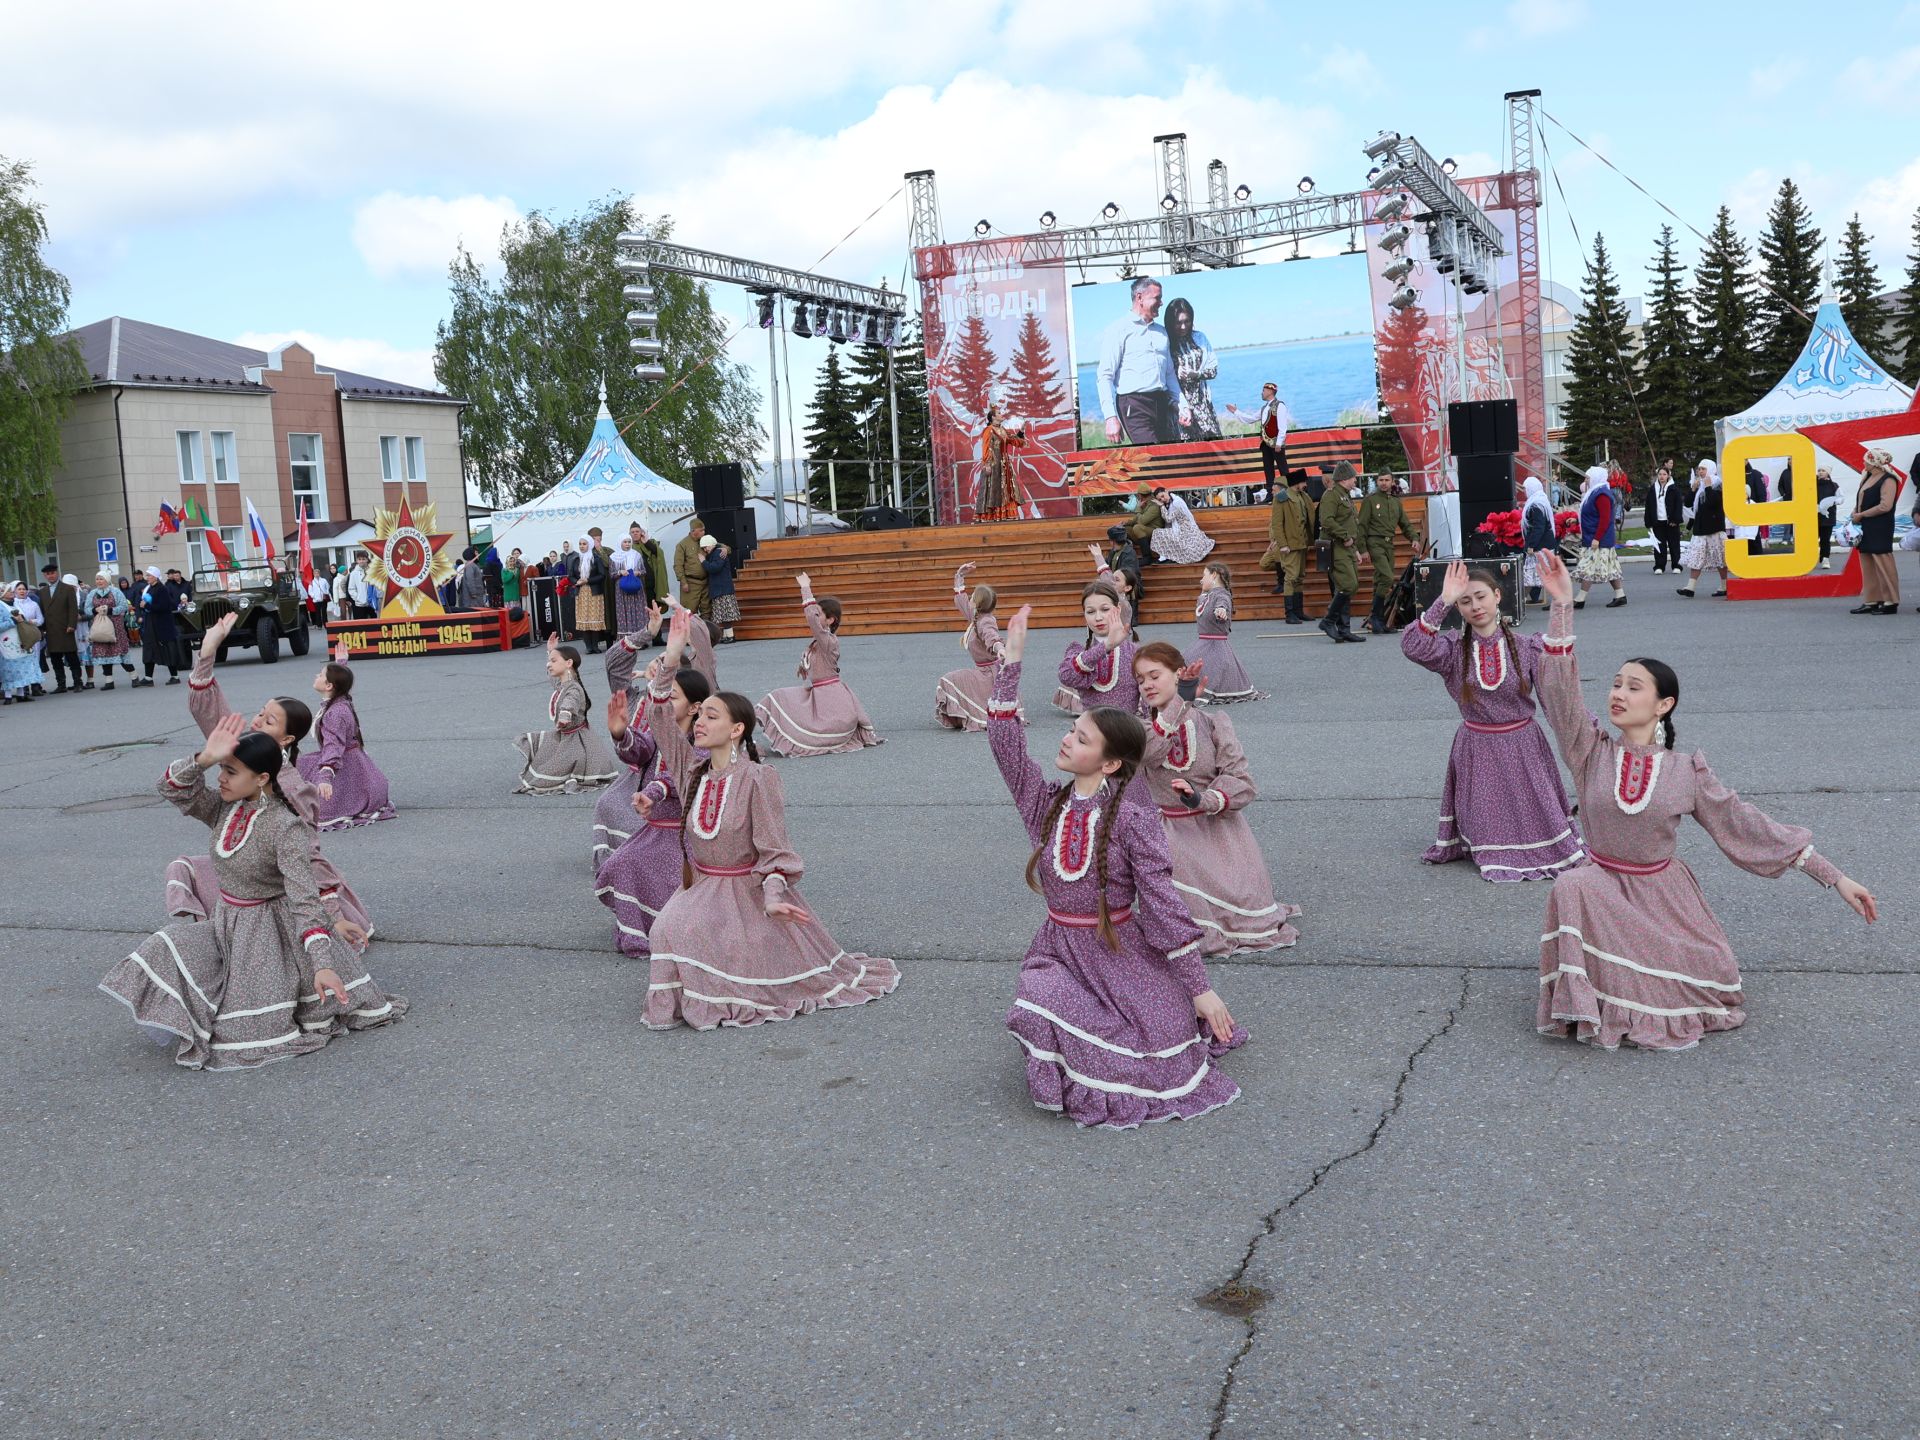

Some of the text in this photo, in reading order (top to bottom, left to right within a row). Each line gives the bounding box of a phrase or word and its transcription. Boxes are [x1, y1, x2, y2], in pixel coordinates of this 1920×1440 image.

[954, 254, 1024, 297] День
[1721, 433, 1820, 579] 9
[102, 541, 113, 560] P
[381, 622, 420, 639] С ДНЁМ
[437, 624, 472, 645] 1945
[378, 639, 428, 655] ПОБЕДЫ!
